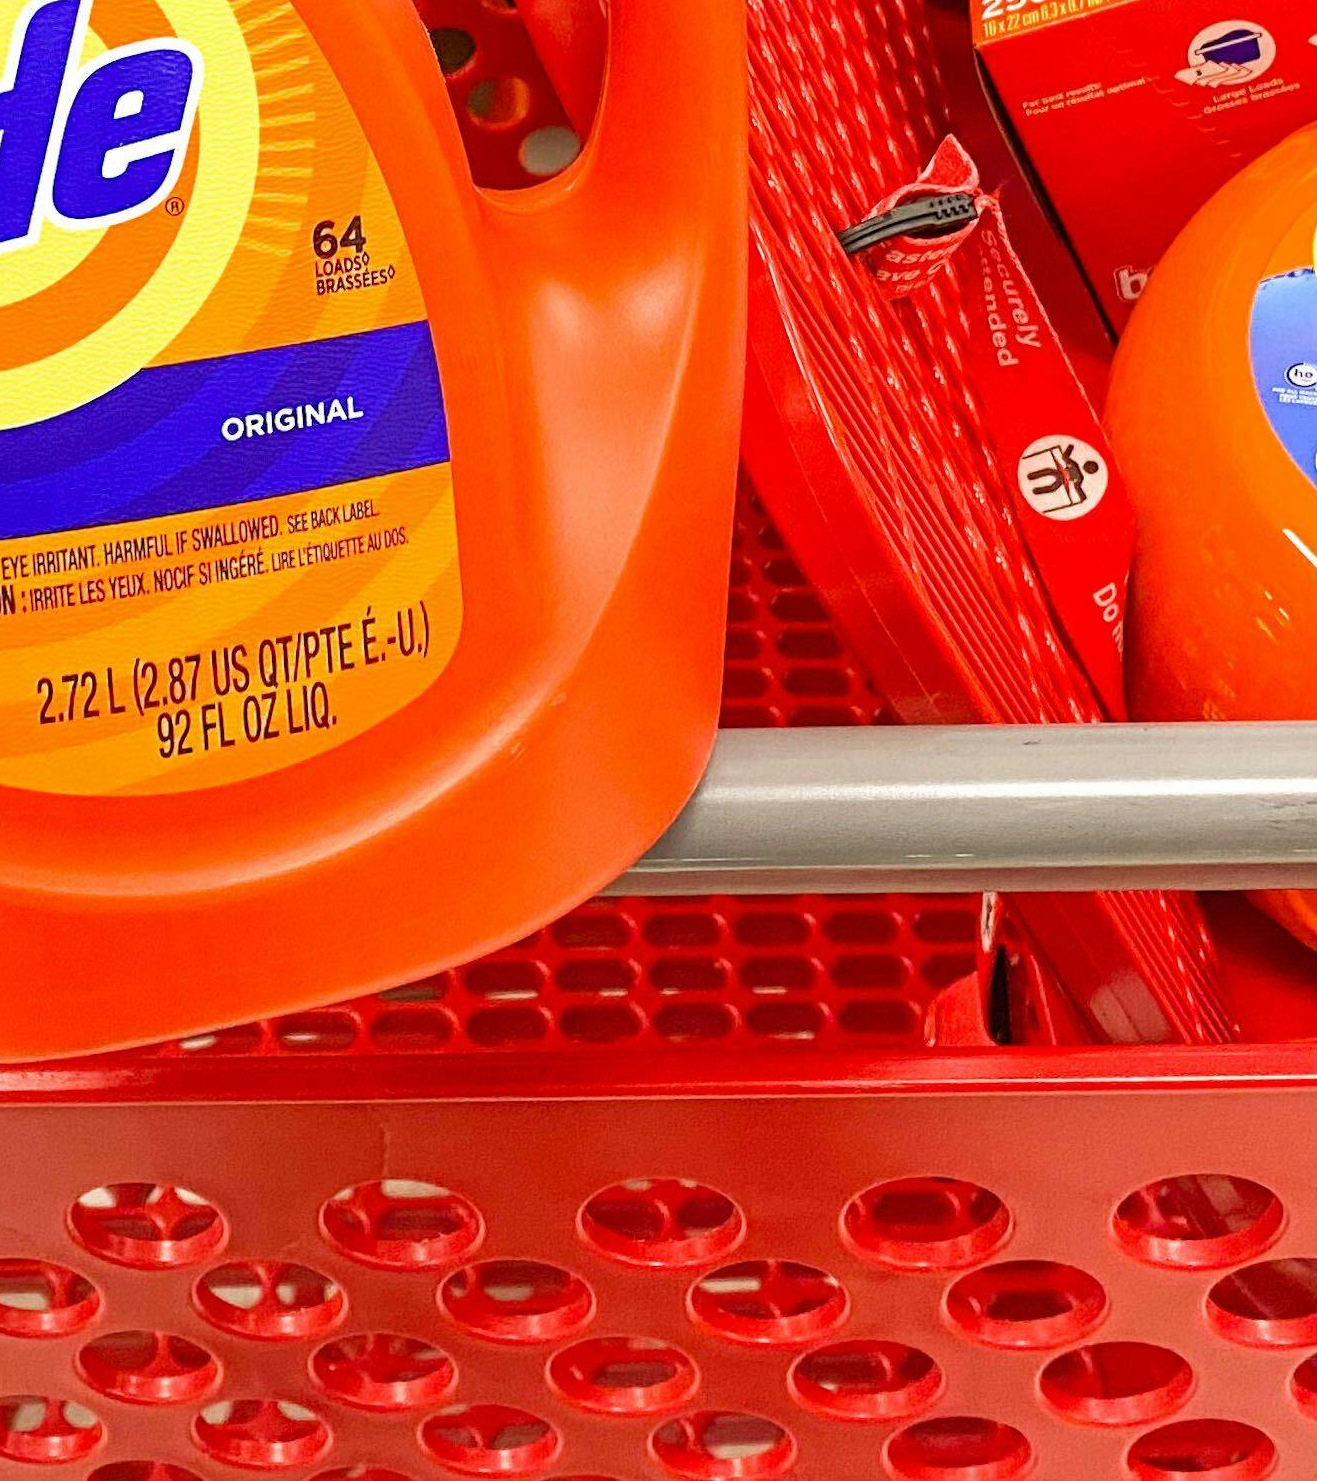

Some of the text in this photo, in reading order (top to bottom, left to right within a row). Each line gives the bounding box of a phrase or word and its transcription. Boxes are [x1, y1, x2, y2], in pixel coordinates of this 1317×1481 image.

[313, 215, 367, 260] 64
[221, 396, 364, 442] ORIGINAL
[2, 555, 29, 580] EYE
[33, 545, 100, 575] IRRITANT.
[103, 534, 173, 565] HARMFUL
[176, 531, 187, 554] IF
[192, 515, 283, 551] SWALLOWED.
[287, 514, 309, 533] SEE
[312, 507, 340, 529] BACK
[342, 499, 380, 523] LABEL.
[30, 584, 75, 612] IRRITE
[79, 579, 105, 605] LES
[109, 573, 150, 601] YEUX.
[154, 564, 194, 593] NOCIF
[199, 562, 211, 585] SI
[215, 547, 269, 582] INGÉRÉ.
[271, 552, 296, 572] LIRE
[299, 536, 364, 567] L'ÉTIQUETTE
[367, 533, 381, 552] AU
[384, 527, 409, 548] DOS.
[1093, 582, 1119, 622] Do
[36, 671, 100, 724] 2.72
[107, 667, 125, 714] L
[132, 655, 201, 715] (2.87
[211, 644, 250, 697] US
[259, 623, 355, 687] QT/PTE
[157, 682, 337, 759] 92 FL OZ LIQ.
